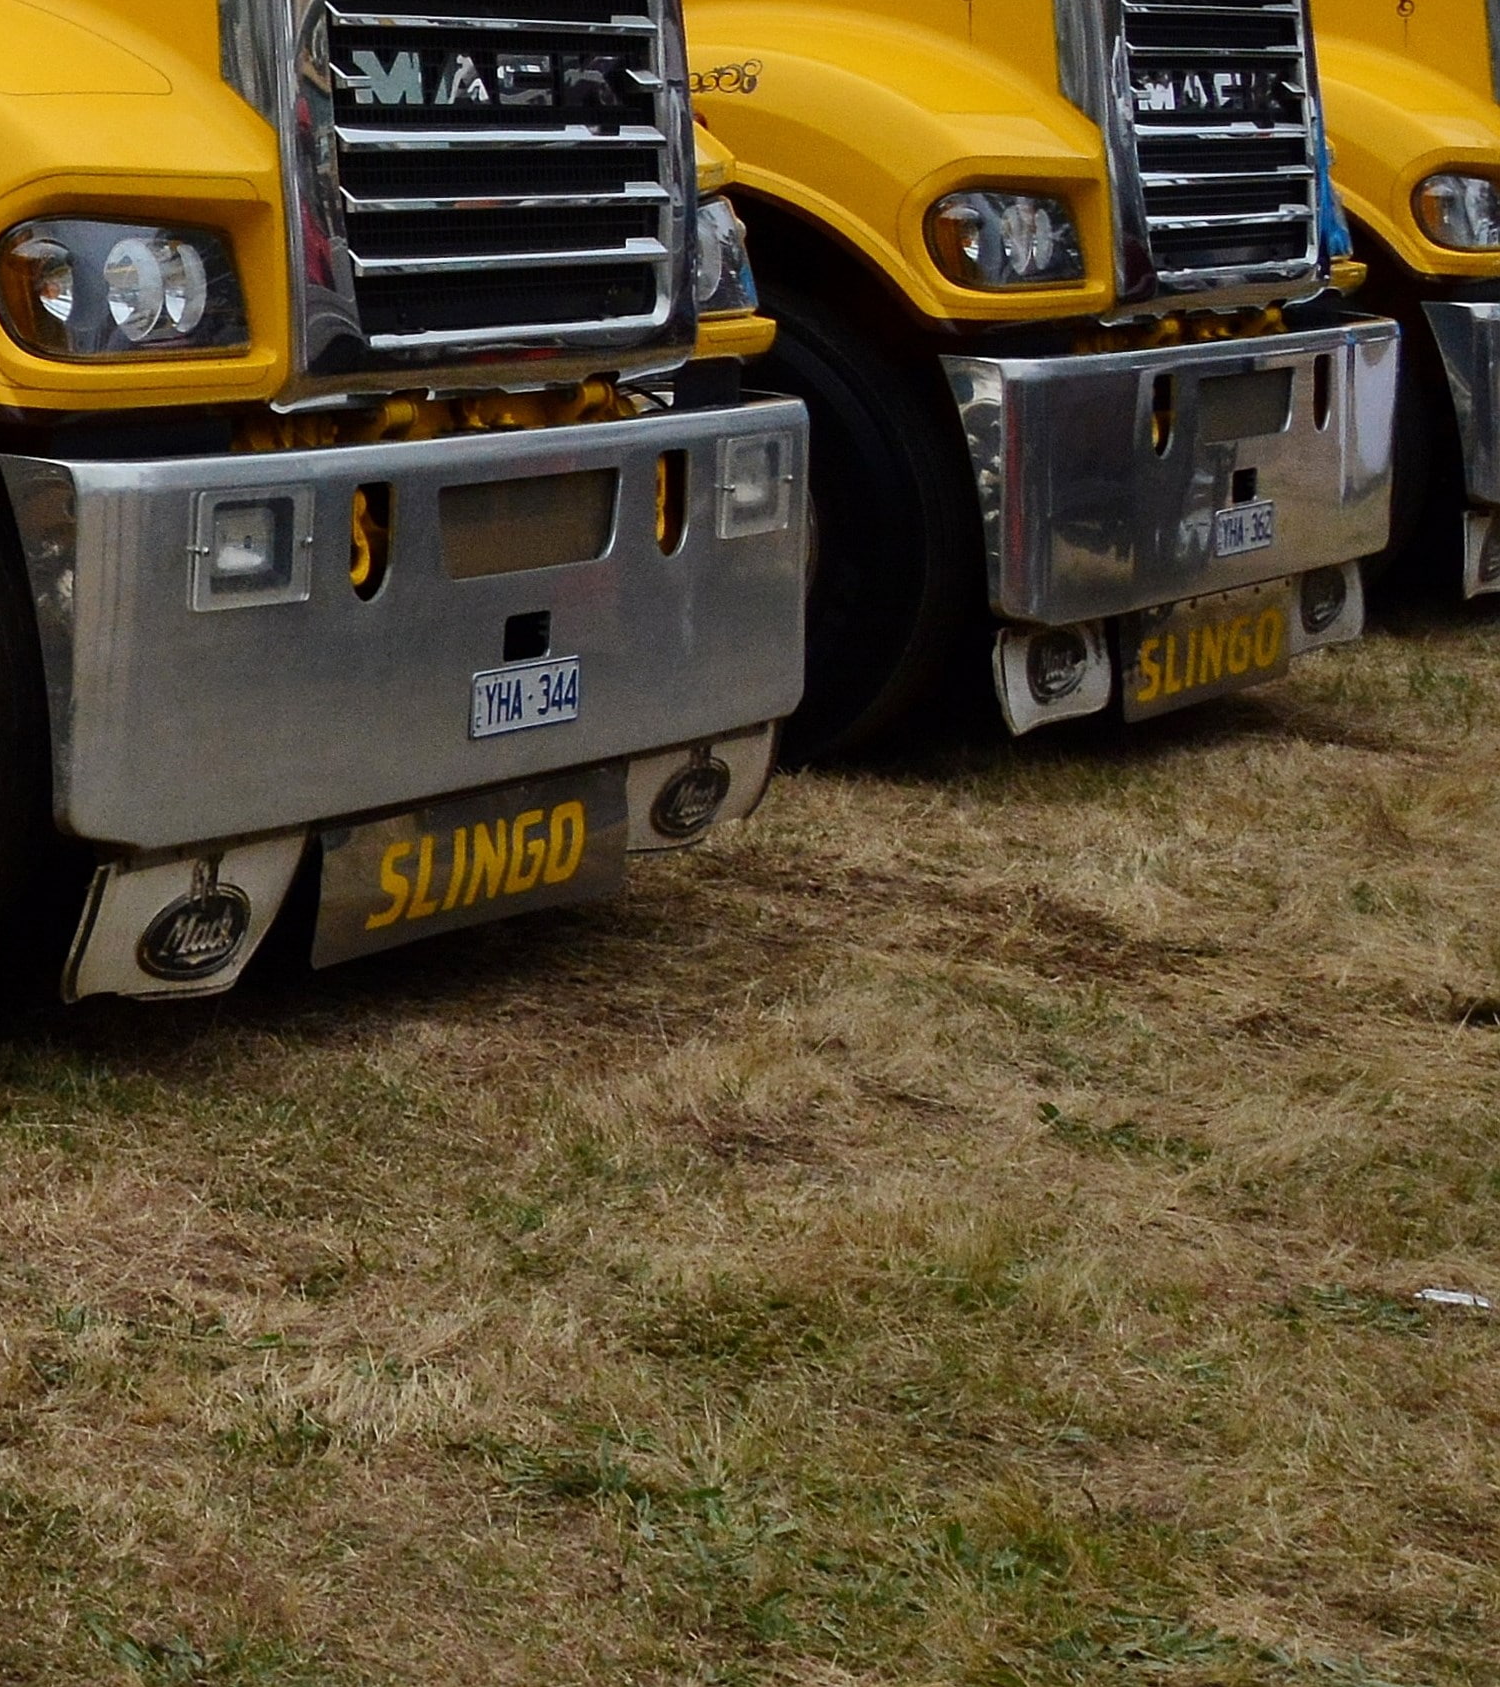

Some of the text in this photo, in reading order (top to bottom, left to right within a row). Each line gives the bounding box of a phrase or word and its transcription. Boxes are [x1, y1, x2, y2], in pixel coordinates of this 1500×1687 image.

[352, 50, 618, 105] MACK
[1136, 606, 1285, 703] SLINGO
[365, 800, 585, 931] SLINGO
